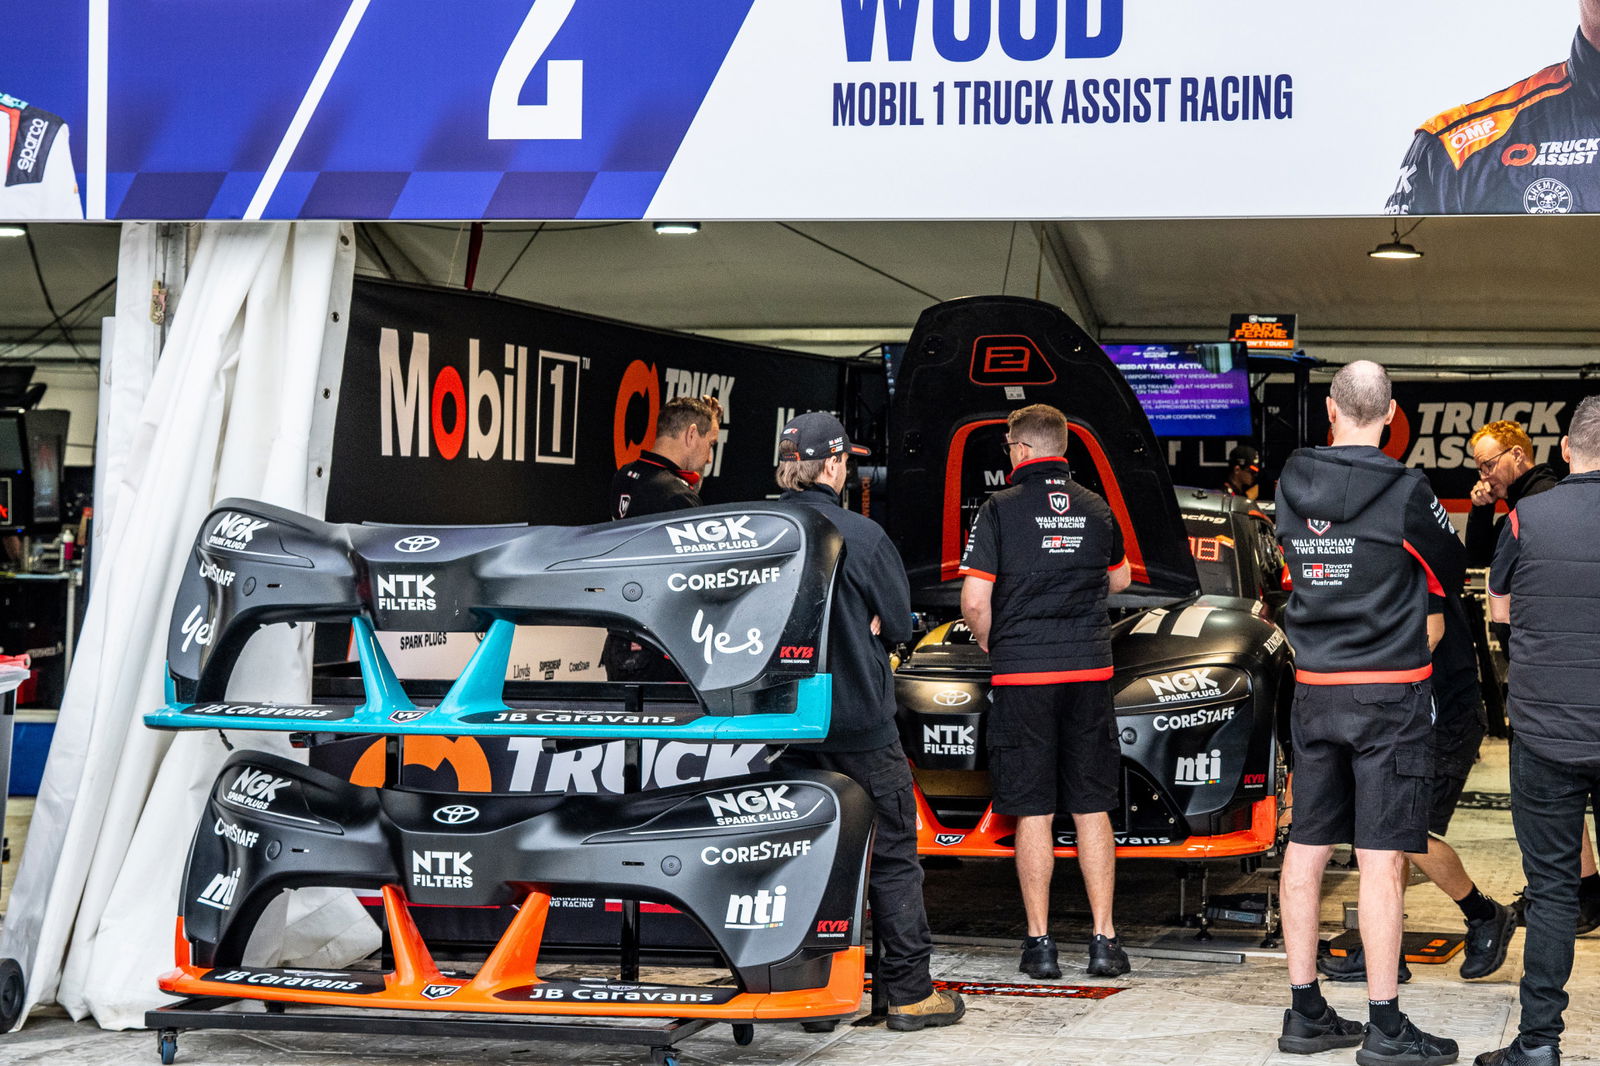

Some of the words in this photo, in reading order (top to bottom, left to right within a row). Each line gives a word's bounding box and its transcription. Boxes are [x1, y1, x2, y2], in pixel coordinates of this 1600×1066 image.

[833, 82, 924, 126] MOBIL
[932, 82, 944, 125] 1
[954, 80, 1054, 125] TRUCK
[1061, 78, 1171, 124] ASSIST
[1180, 74, 1293, 121] RACING
[1451, 120, 1496, 149] OMP
[17, 118, 48, 173] sparco
[1539, 138, 1600, 154] TRUCK
[1532, 151, 1597, 166] ASSIST
[1528, 181, 1569, 201] CHEMICAL
[1234, 329, 1288, 339] FERME
[1241, 322, 1283, 334] PARC
[379, 327, 528, 461] Mobil
[1418, 402, 1566, 434] TRUCK
[212, 512, 269, 543] NGK
[665, 515, 758, 546] NGK
[224, 539, 247, 550] PLUGS
[675, 544, 717, 553] SPARK
[718, 540, 758, 550] PLUGS
[1291, 538, 1356, 547] WALKINSHAW
[1317, 546, 1353, 554] RACING
[377, 574, 436, 598] NTK
[378, 598, 437, 611] FILTERS
[400, 635, 424, 650] SPARK
[424, 632, 448, 646] PLUGS
[779, 646, 815, 659] KYB
[1147, 668, 1218, 697] NGK
[1158, 693, 1190, 703] SPARK
[1191, 688, 1221, 698] PLUGS
[217, 707, 332, 718] Caravans
[493, 713, 524, 722] JB
[536, 713, 676, 724] Caravans
[923, 724, 975, 745] NTK
[924, 743, 975, 755] FILTERS
[507, 737, 766, 795] TRUCK
[1175, 749, 1221, 784] nti
[231, 767, 292, 802] NGK
[1243, 773, 1266, 784] KYB
[246, 796, 270, 810] PLUGS
[706, 785, 796, 817] NGK
[716, 816, 756, 826] SPARK
[758, 810, 799, 822] PLUGS
[412, 850, 473, 876] NTK
[413, 876, 474, 888] FILTERS
[562, 900, 594, 908] RACING
[725, 885, 788, 926] nti
[816, 919, 850, 933] KYB
[214, 970, 244, 982] JB
[246, 973, 363, 990] Caravans
[529, 988, 563, 1000] JB
[572, 989, 713, 1002] Caravans
